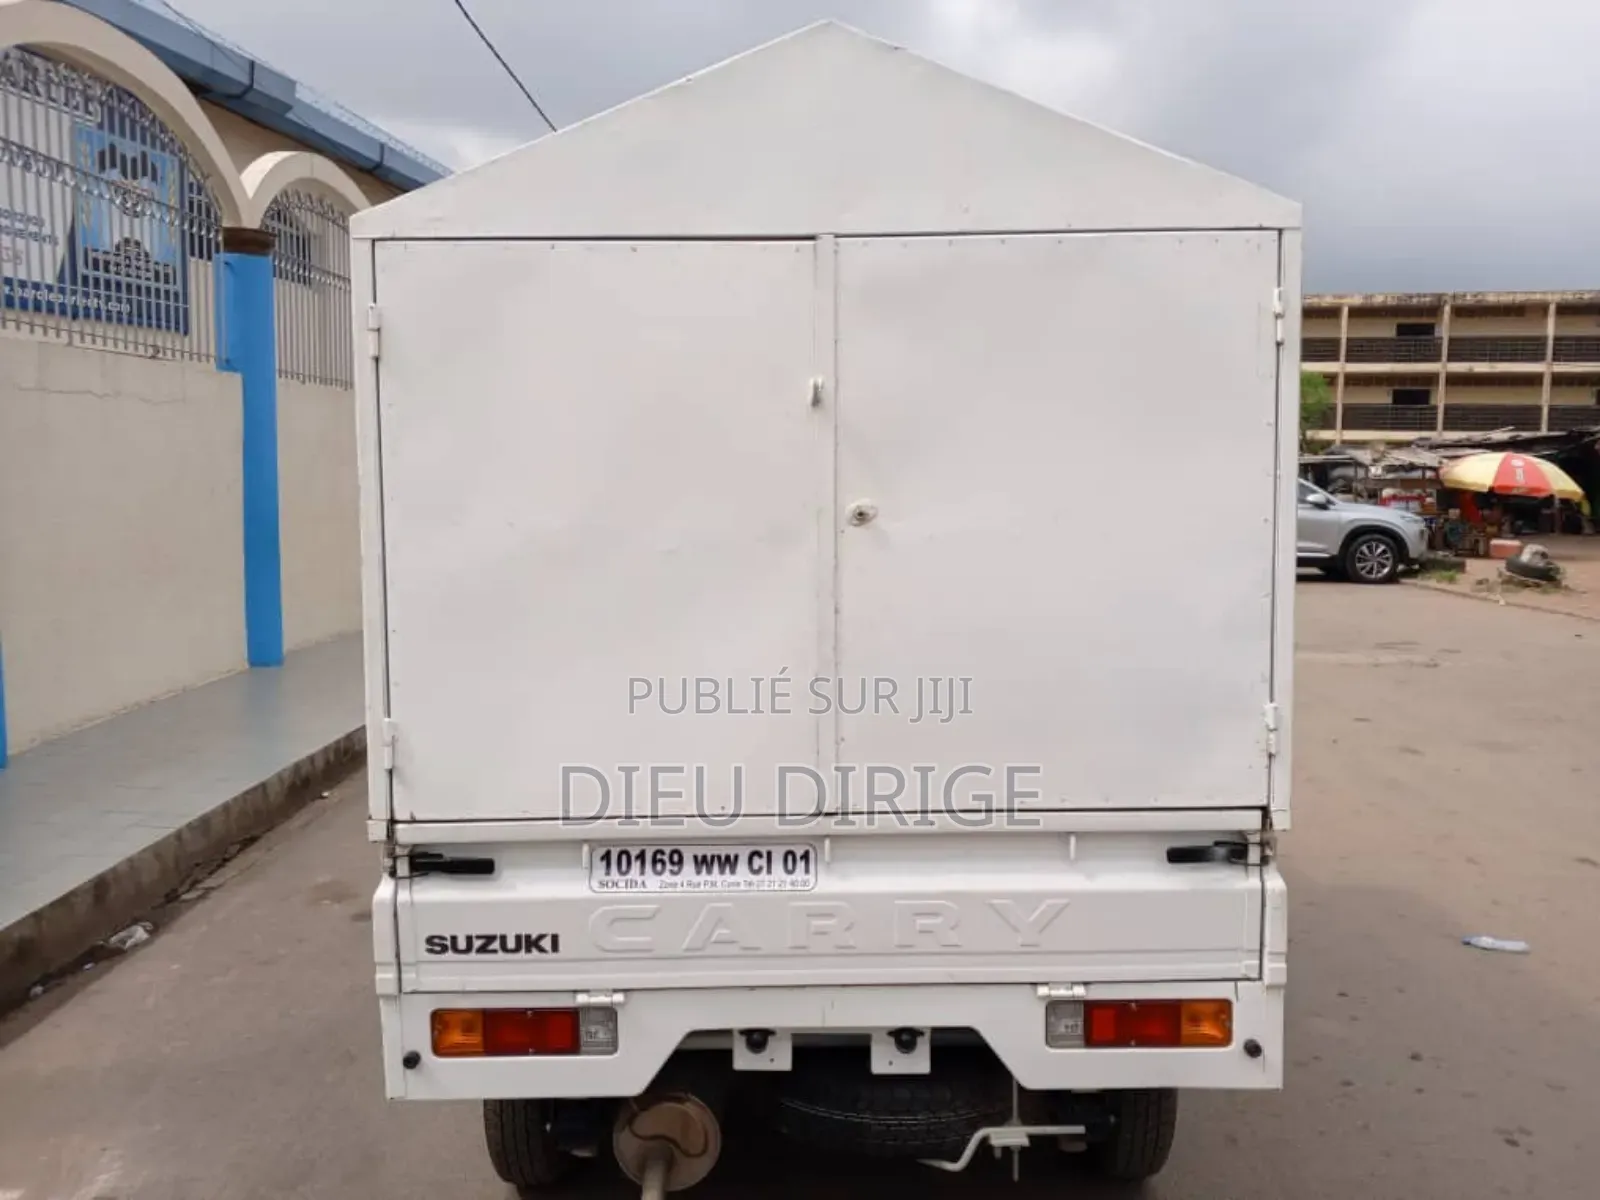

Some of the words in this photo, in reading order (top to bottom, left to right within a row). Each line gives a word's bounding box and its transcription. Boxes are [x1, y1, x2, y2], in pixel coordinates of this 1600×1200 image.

[599, 848, 684, 876] 10169
[747, 850, 773, 875] CI
[783, 849, 811, 875] 01
[588, 897, 1071, 954] CARRY
[424, 932, 561, 955] SUZUKI
